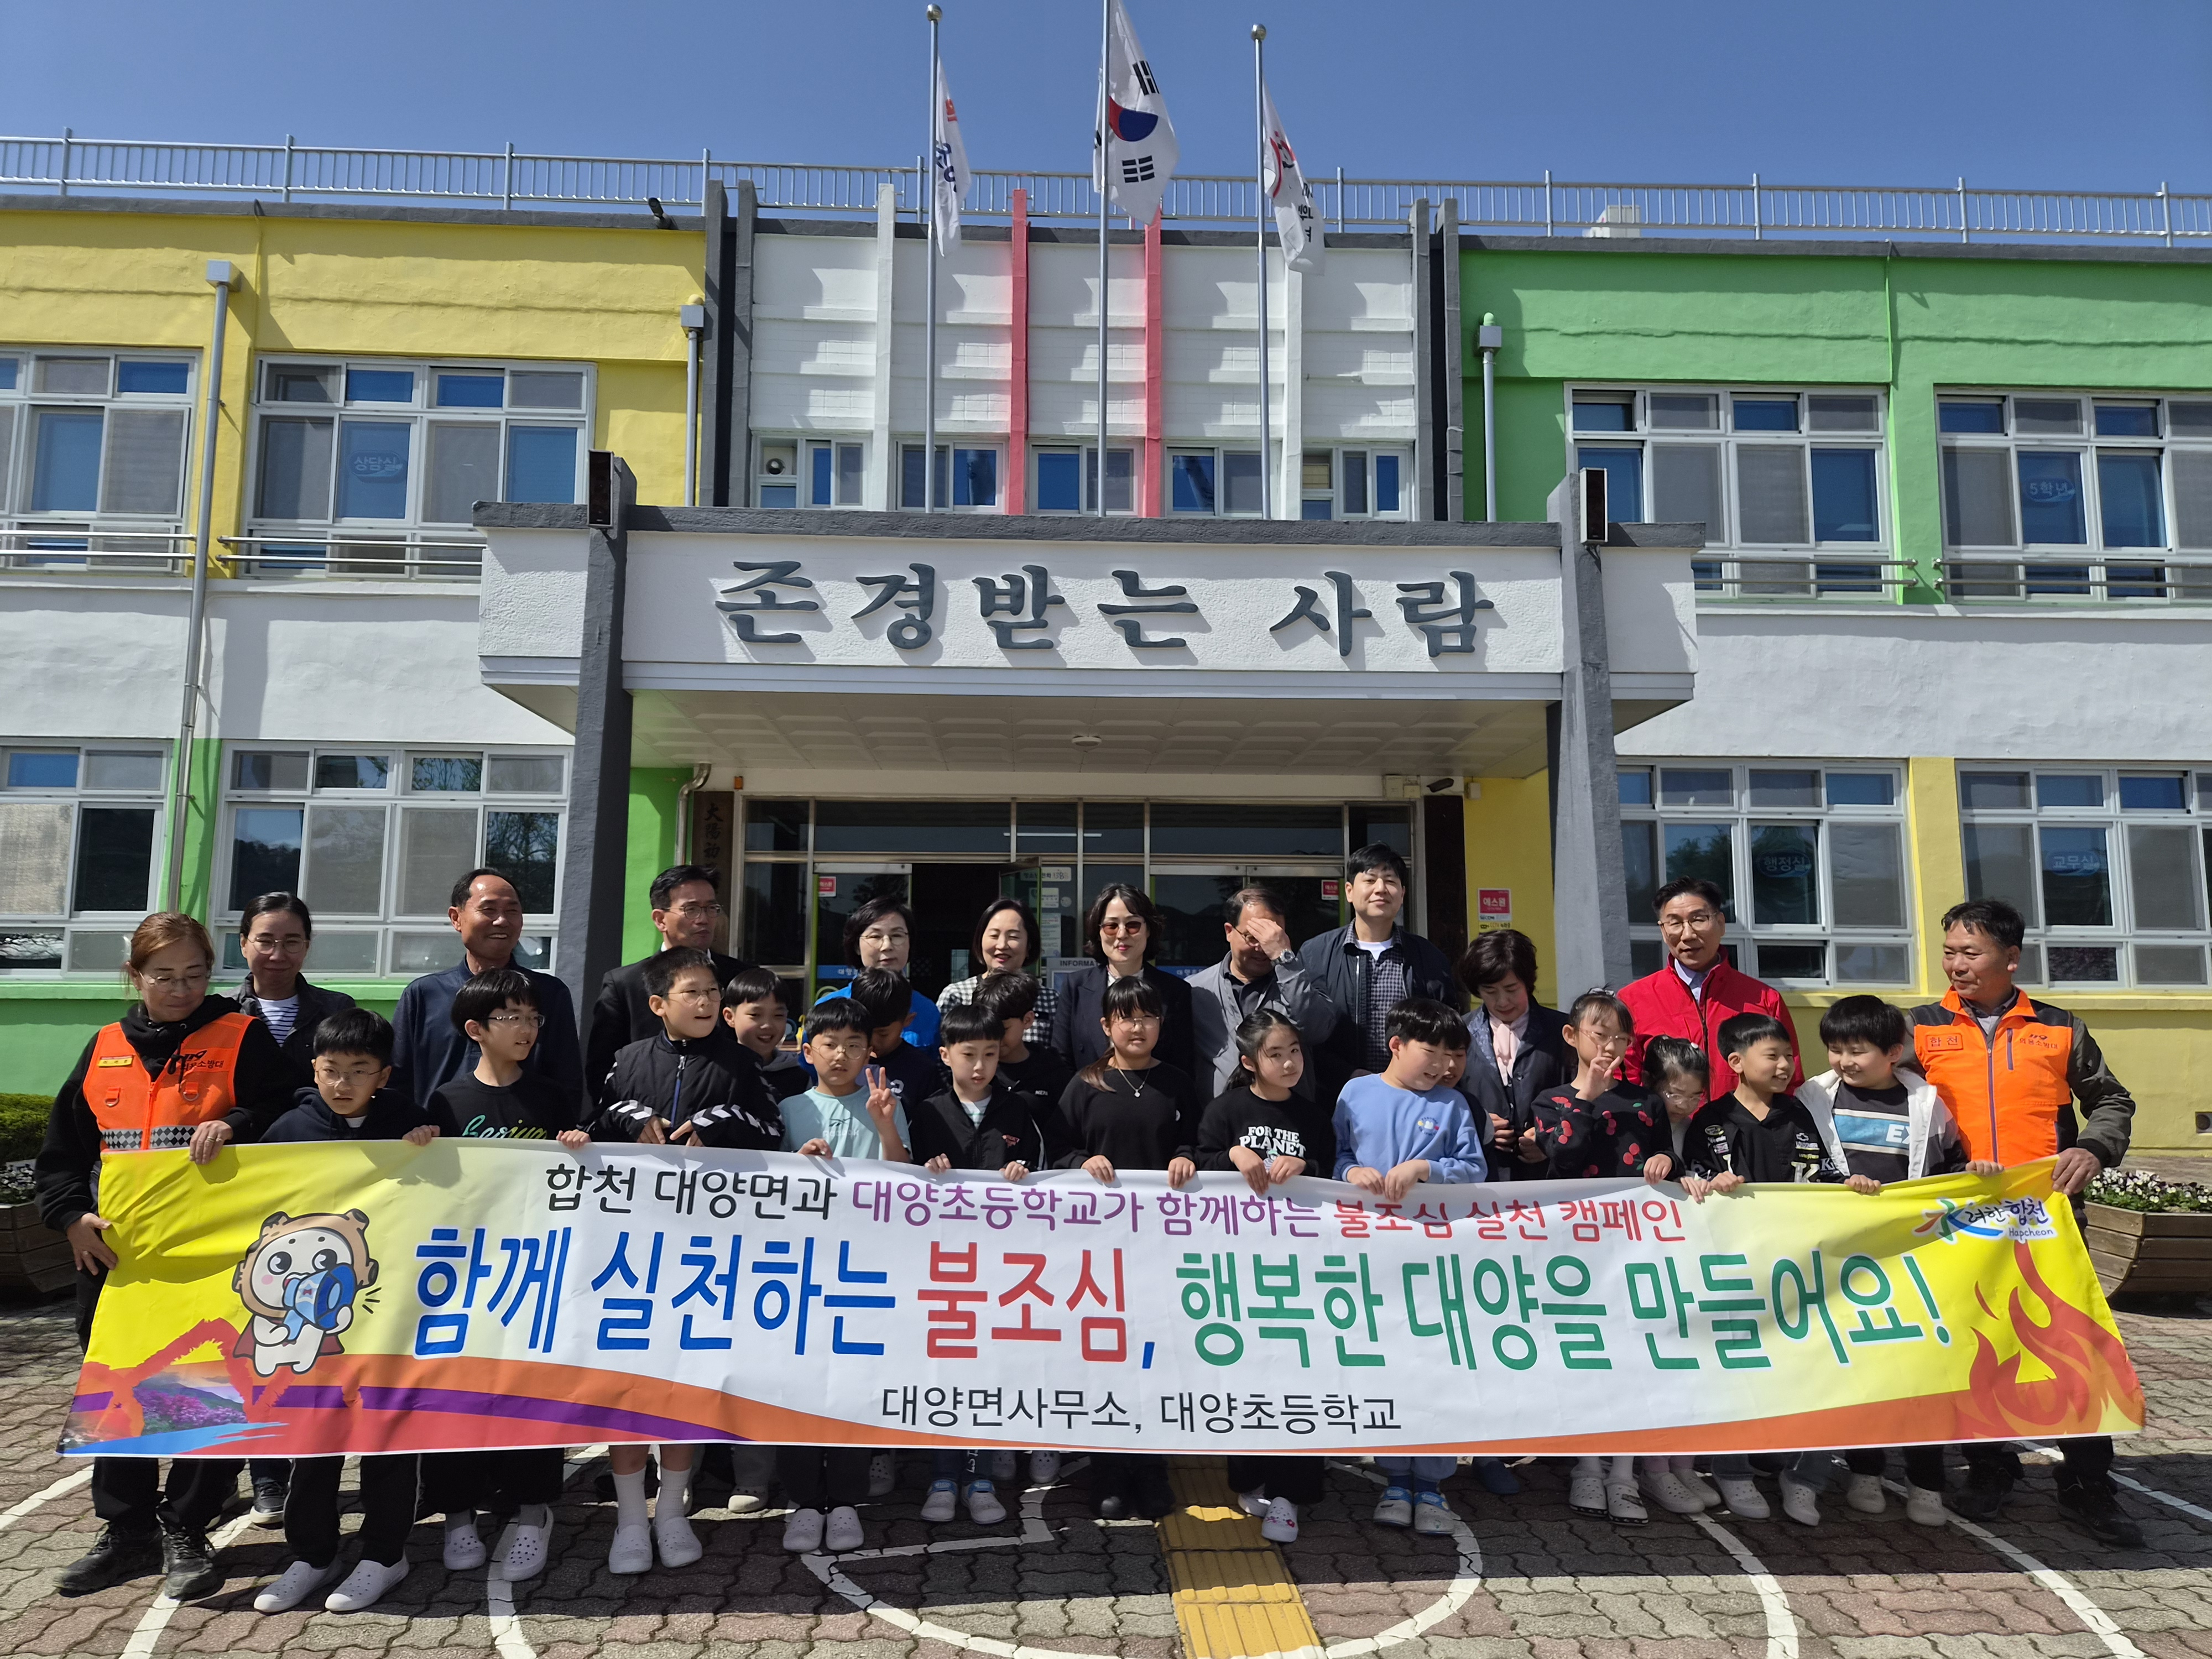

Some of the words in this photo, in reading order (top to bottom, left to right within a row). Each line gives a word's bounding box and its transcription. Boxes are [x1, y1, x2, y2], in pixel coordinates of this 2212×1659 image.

[353, 456, 397, 472] 상담실
[716, 560, 1199, 651] 존경받는
[1269, 570, 1494, 658] 사람
[2052, 855, 2095, 870] 교무실
[1483, 897, 1506, 907] 에스원
[1248, 1125, 1273, 1138] FOR
[1274, 1128, 1301, 1143] THE
[1239, 1135, 1307, 1158] PLANET
[546, 1162, 635, 1213] 합천
[654, 1169, 838, 1220] 대양면과
[852, 1181, 1145, 1232] 대양초등학교가
[1156, 1191, 1320, 1238] 함께하는
[1333, 1197, 1453, 1239] 불조심
[1465, 1197, 1548, 1241] 실천
[1557, 1198, 1686, 1243] 캠페인
[2008, 1227, 2053, 1241] Hapcheon
[415, 1226, 571, 1357] 함께
[591, 1231, 896, 1356] 실천하는
[917, 1240, 1156, 1369] 불조심,
[1175, 1251, 1387, 1369] 행복한
[1401, 1253, 1612, 1370] 대양을
[1624, 1248, 1951, 1369] 만들어요!
[881, 1384, 1143, 1433] 대양면사무소,
[1160, 1390, 1402, 1434] 대양초등학교
